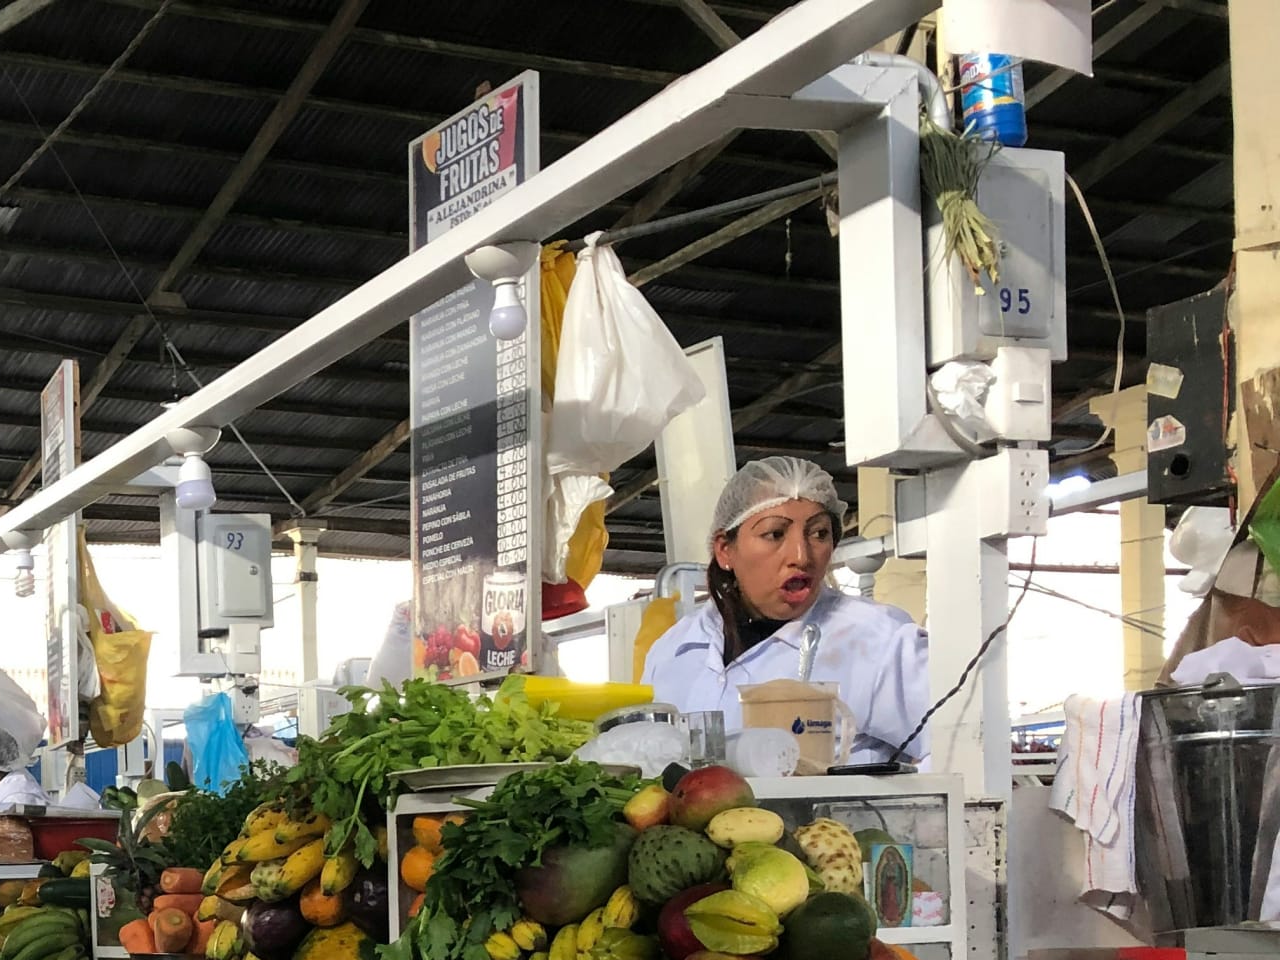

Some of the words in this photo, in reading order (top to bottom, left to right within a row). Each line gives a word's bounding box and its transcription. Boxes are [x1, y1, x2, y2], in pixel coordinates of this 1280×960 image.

[436, 105, 488, 164] JUGOS
[490, 107, 503, 134] DE
[440, 140, 499, 201] FRUTAS
[1000, 288, 1030, 314] 95
[227, 532, 244, 550] 93
[422, 531, 443, 545] POMELO
[451, 536, 474, 550] CERVEZA
[484, 588, 524, 616] GLORIA
[487, 649, 516, 666] LECHE
